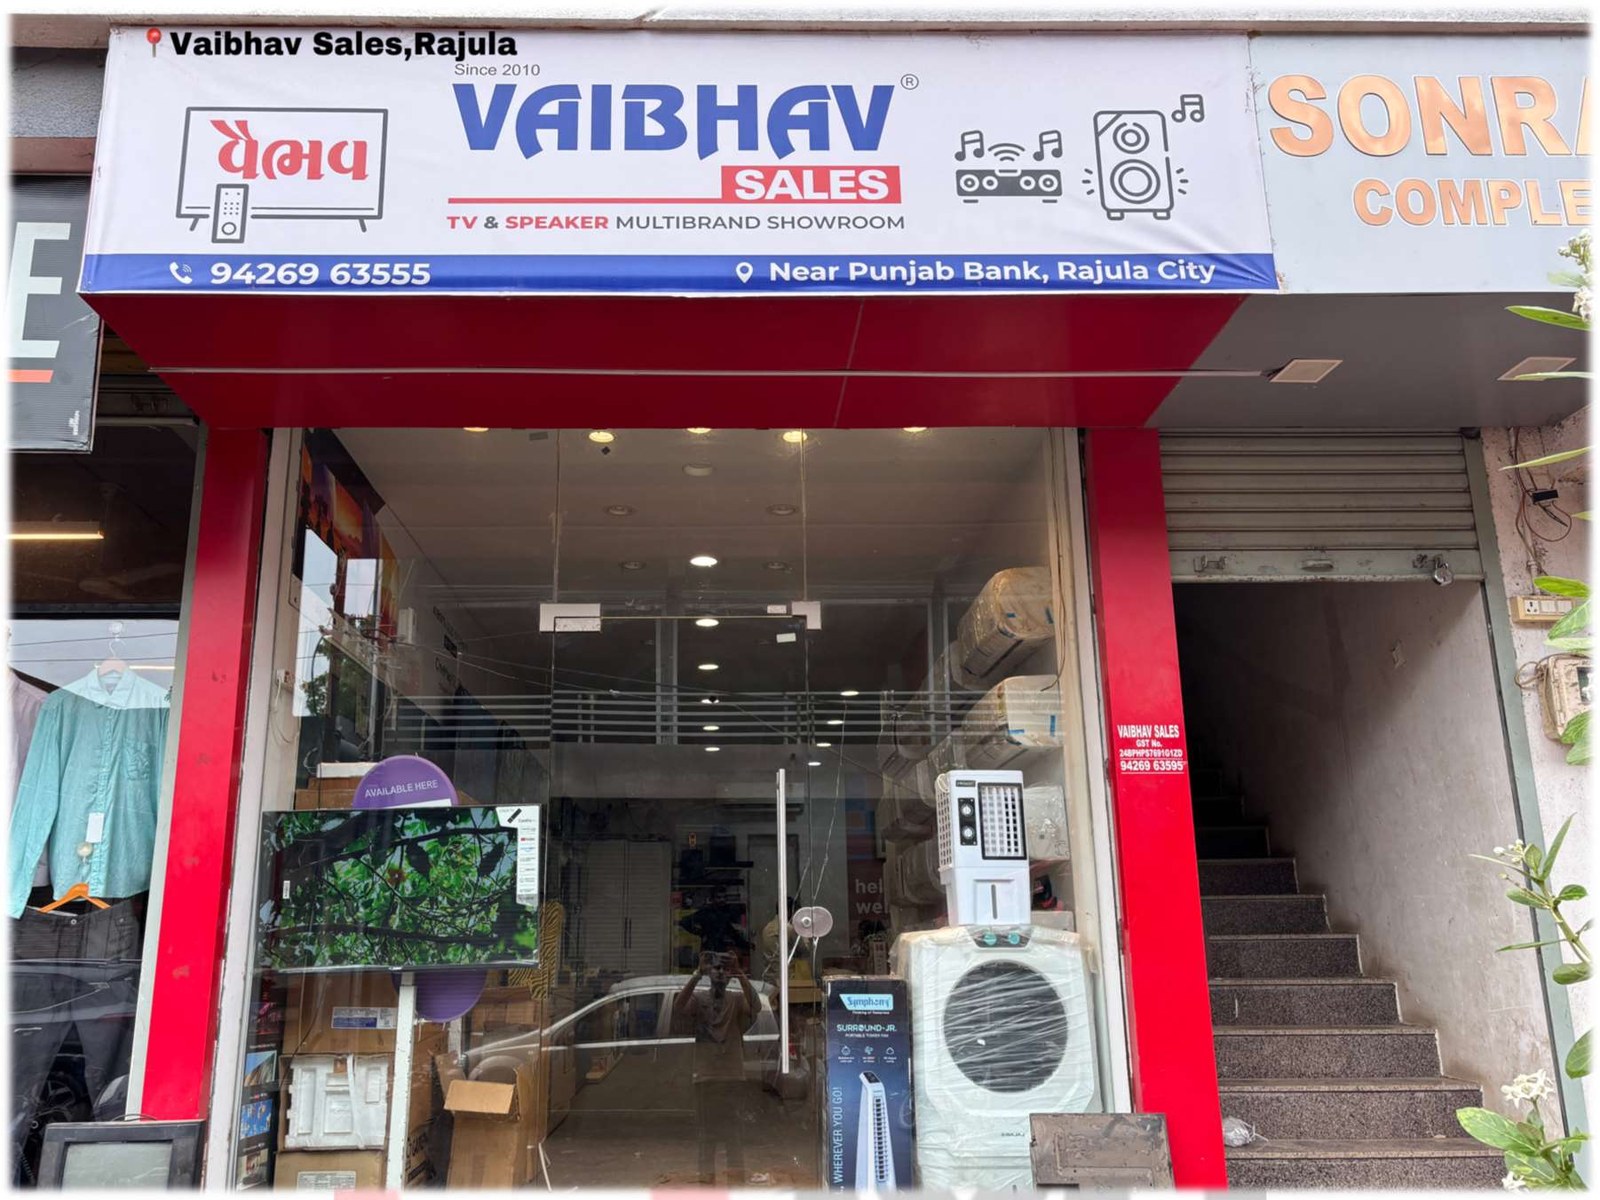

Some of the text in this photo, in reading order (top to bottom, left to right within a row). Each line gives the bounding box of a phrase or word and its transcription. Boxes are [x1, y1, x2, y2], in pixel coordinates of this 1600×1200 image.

[454, 64, 540, 76] Since 2010
[452, 83, 895, 160] VAIBHAV
[210, 119, 369, 180] વૈભવ
[735, 168, 889, 201] SALES
[447, 215, 905, 231] TV & SPEAKER MULTIBRAND SHOWROOM
[210, 263, 431, 286] 94269 63555
[770, 260, 1216, 286] Near Punjab Bank, Rajula City
[1117, 724, 1179, 738] VAIBHAV SALES
[1136, 739, 1163, 747] GST No.
[1120, 760, 1184, 771] 94269 63595
[365, 779, 438, 798] AVAILABLE HERE
[832, 1087, 843, 1104] GO!
[833, 1106, 843, 1126] YOU
[832, 1128, 844, 1183] WHEREVER
